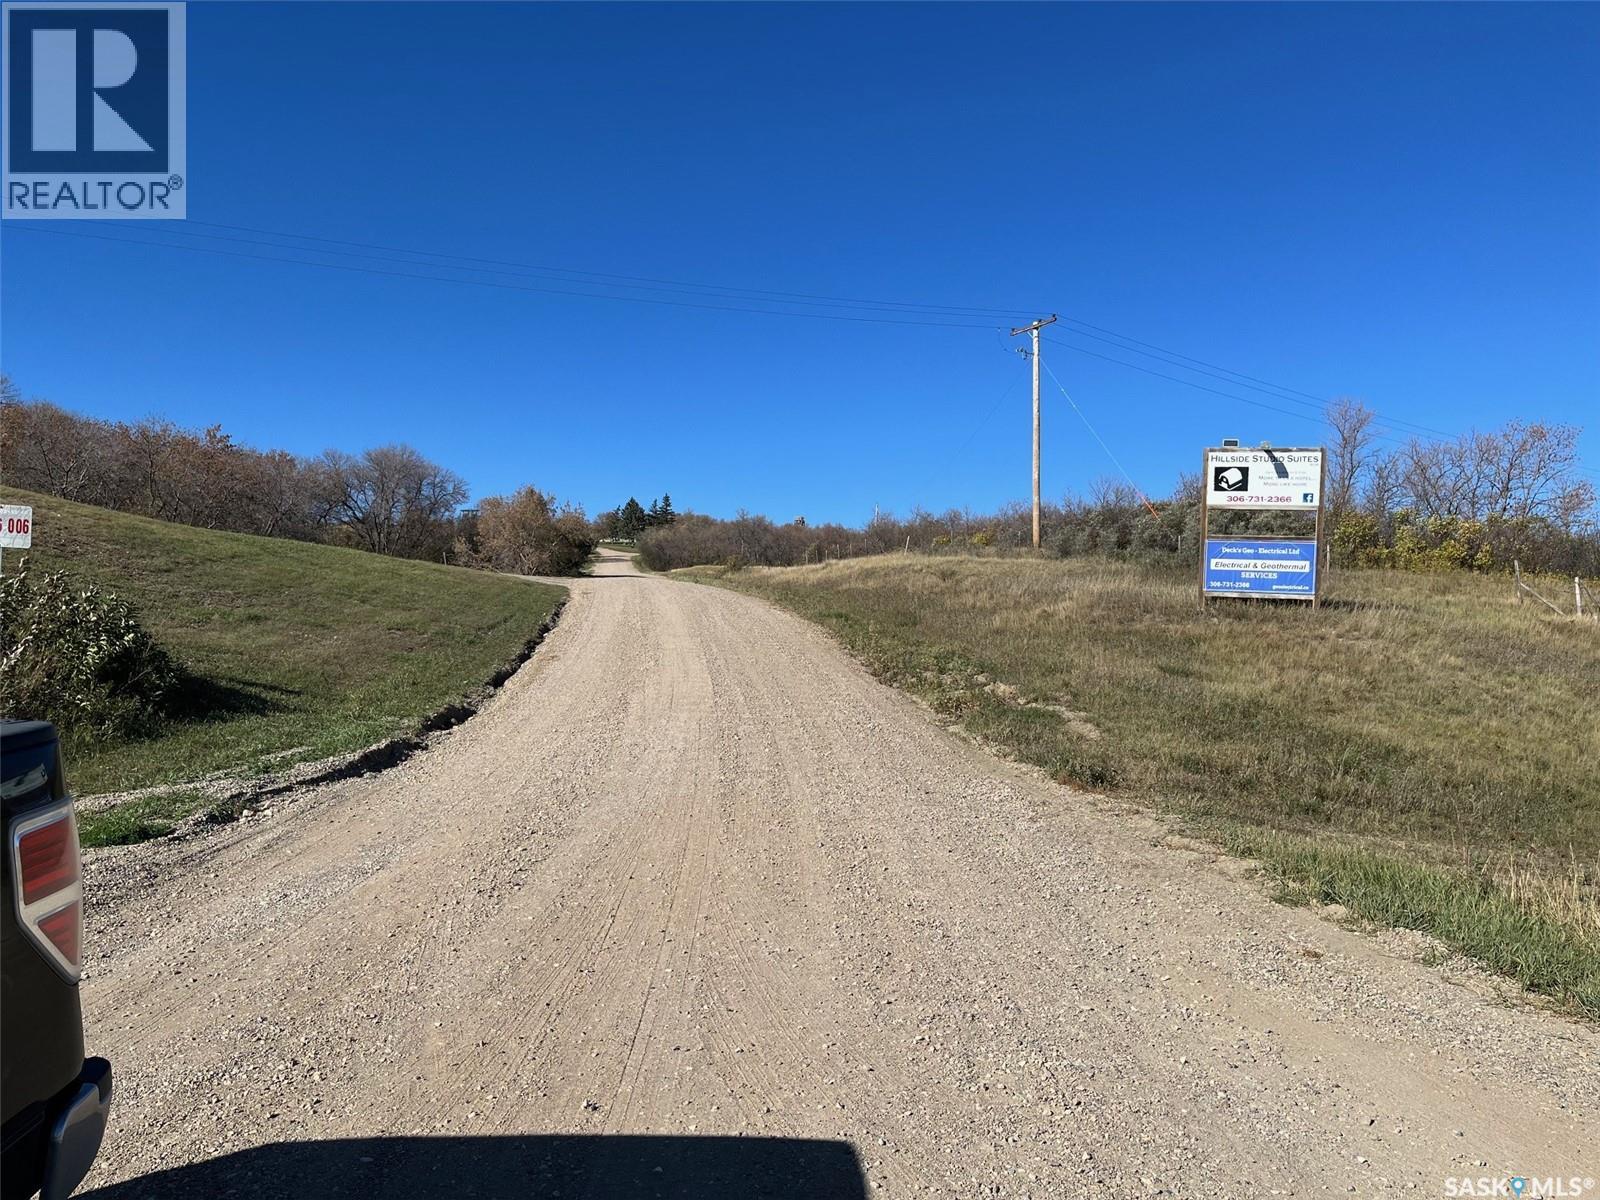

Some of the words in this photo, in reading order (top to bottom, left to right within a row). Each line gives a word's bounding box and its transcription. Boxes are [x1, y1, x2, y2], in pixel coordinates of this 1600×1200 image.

[1211, 455, 1250, 463] HILLSIDE
[1287, 454, 1319, 463] SUITES
[1260, 562, 1307, 571] Geothermal
